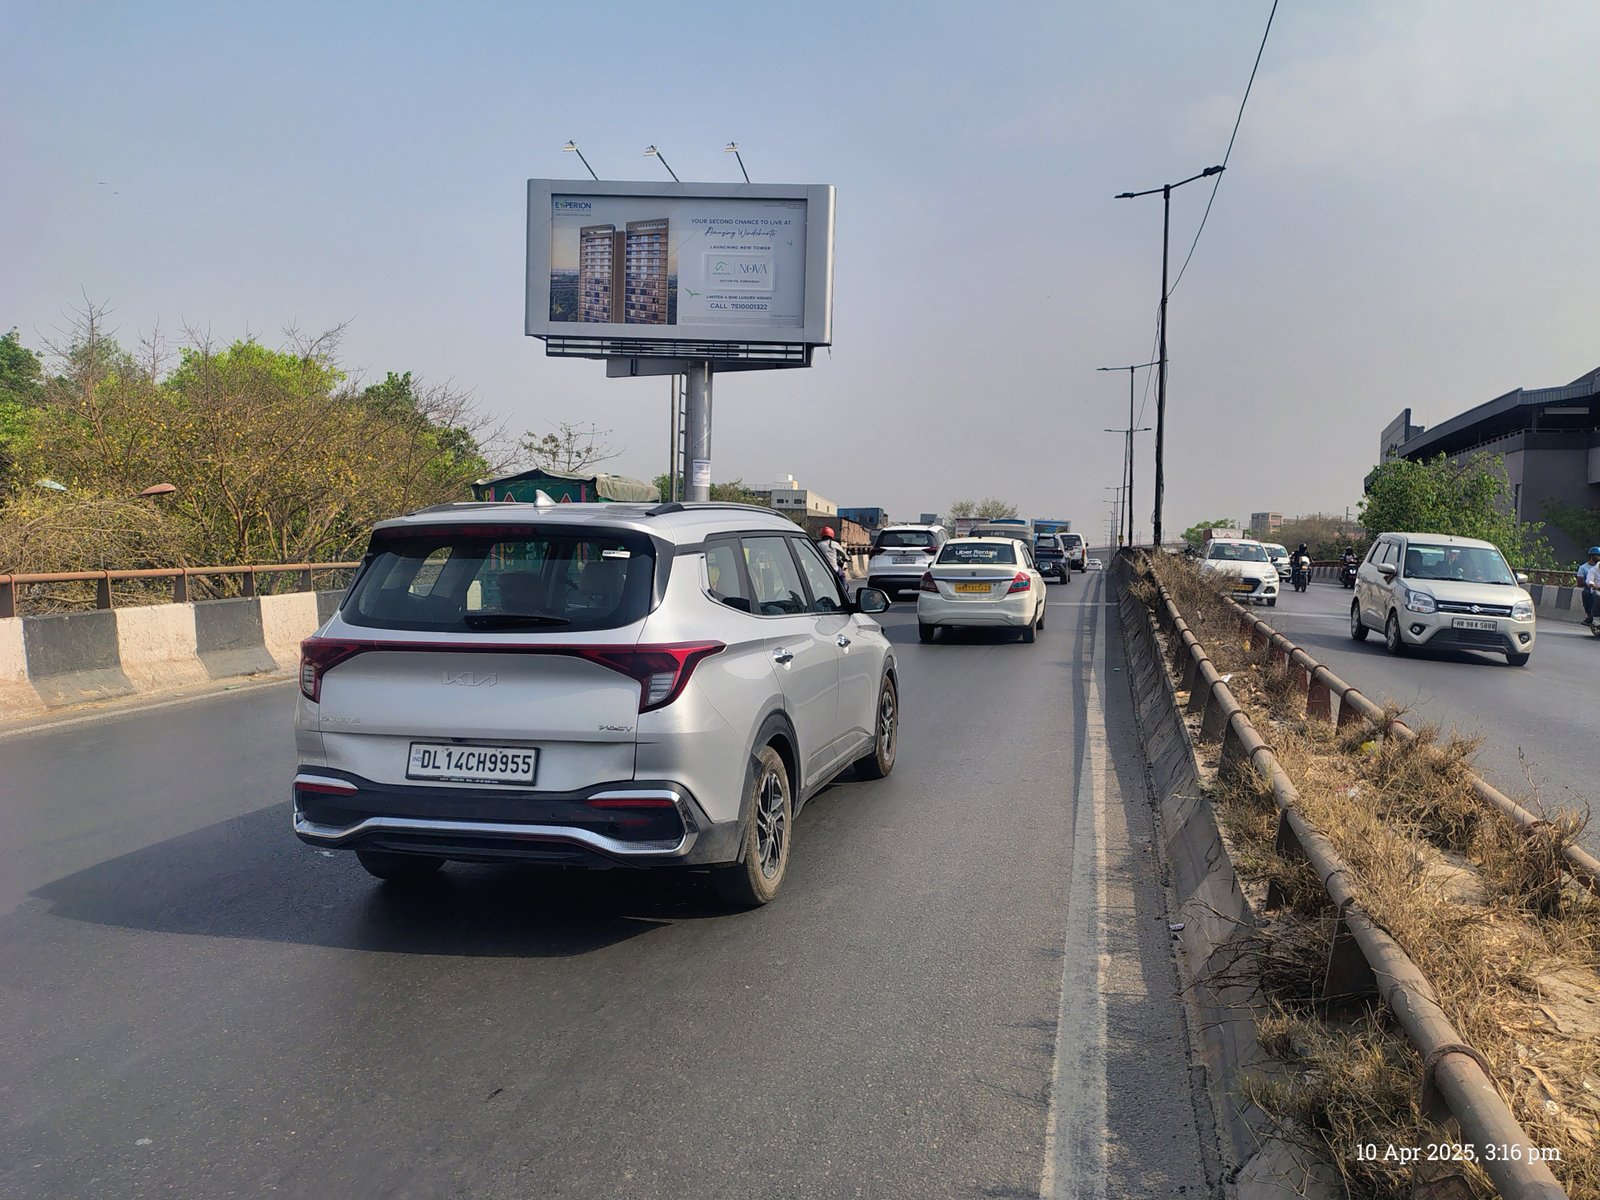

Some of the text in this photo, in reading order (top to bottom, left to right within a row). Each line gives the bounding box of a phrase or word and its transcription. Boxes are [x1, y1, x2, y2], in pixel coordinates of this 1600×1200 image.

[739, 263, 768, 274] NOVA
[441, 671, 498, 688] KIA
[421, 749, 532, 774] DL14CH9955
